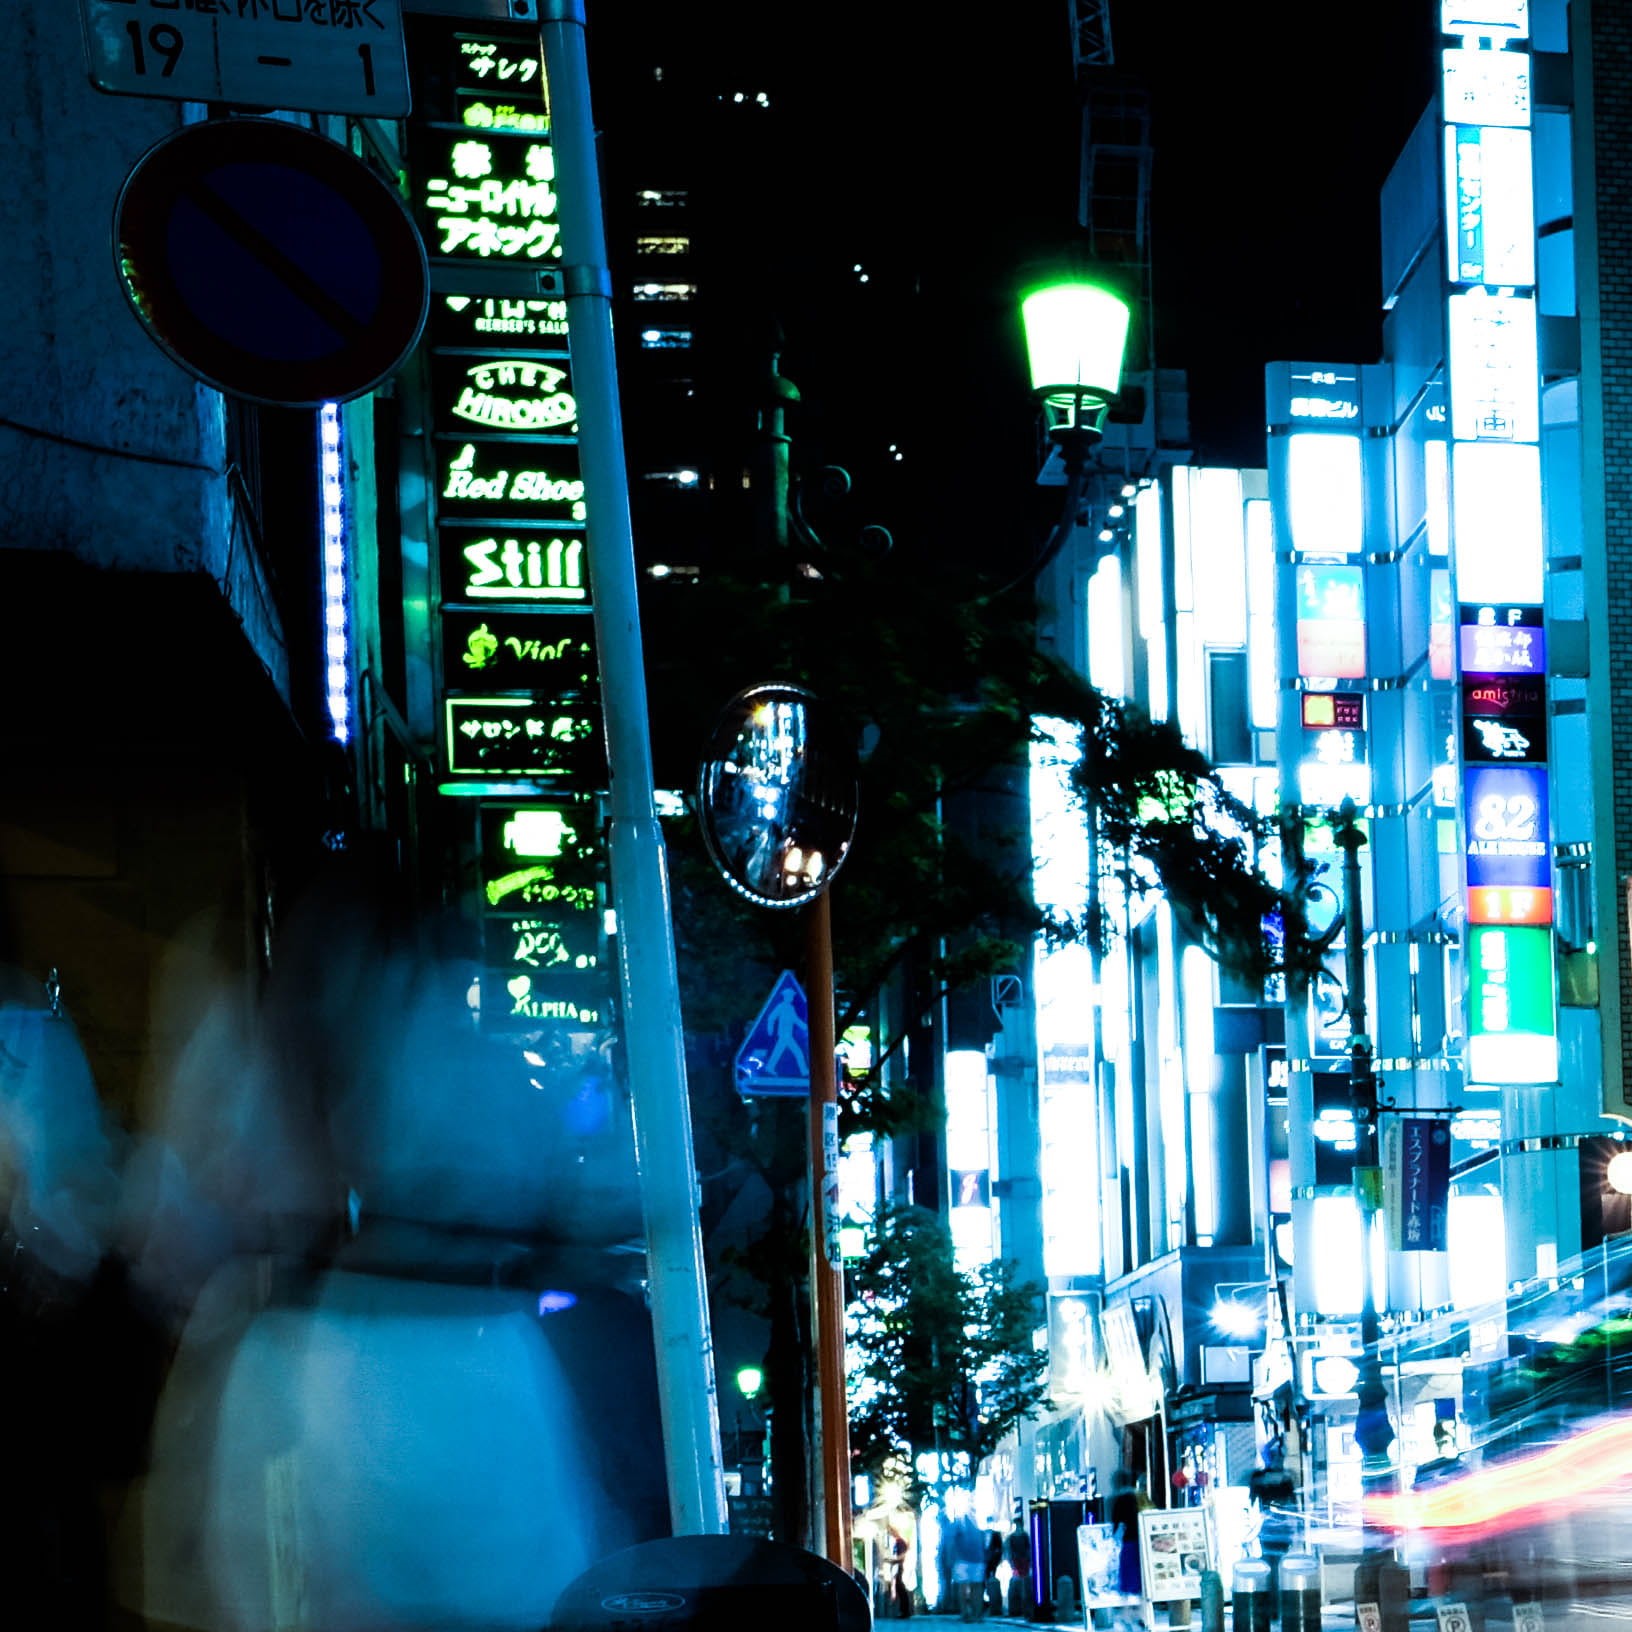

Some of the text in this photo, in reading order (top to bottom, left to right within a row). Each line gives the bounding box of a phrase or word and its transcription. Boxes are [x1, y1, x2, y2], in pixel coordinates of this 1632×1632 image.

[126, 20, 184, 77] 19
[357, 43, 376, 96] 1
[475, 366, 564, 393] CHEZ
[456, 387, 578, 426] HIROKO
[443, 470, 508, 499] Red
[463, 538, 583, 587] Still
[1473, 793, 1537, 841] 82
